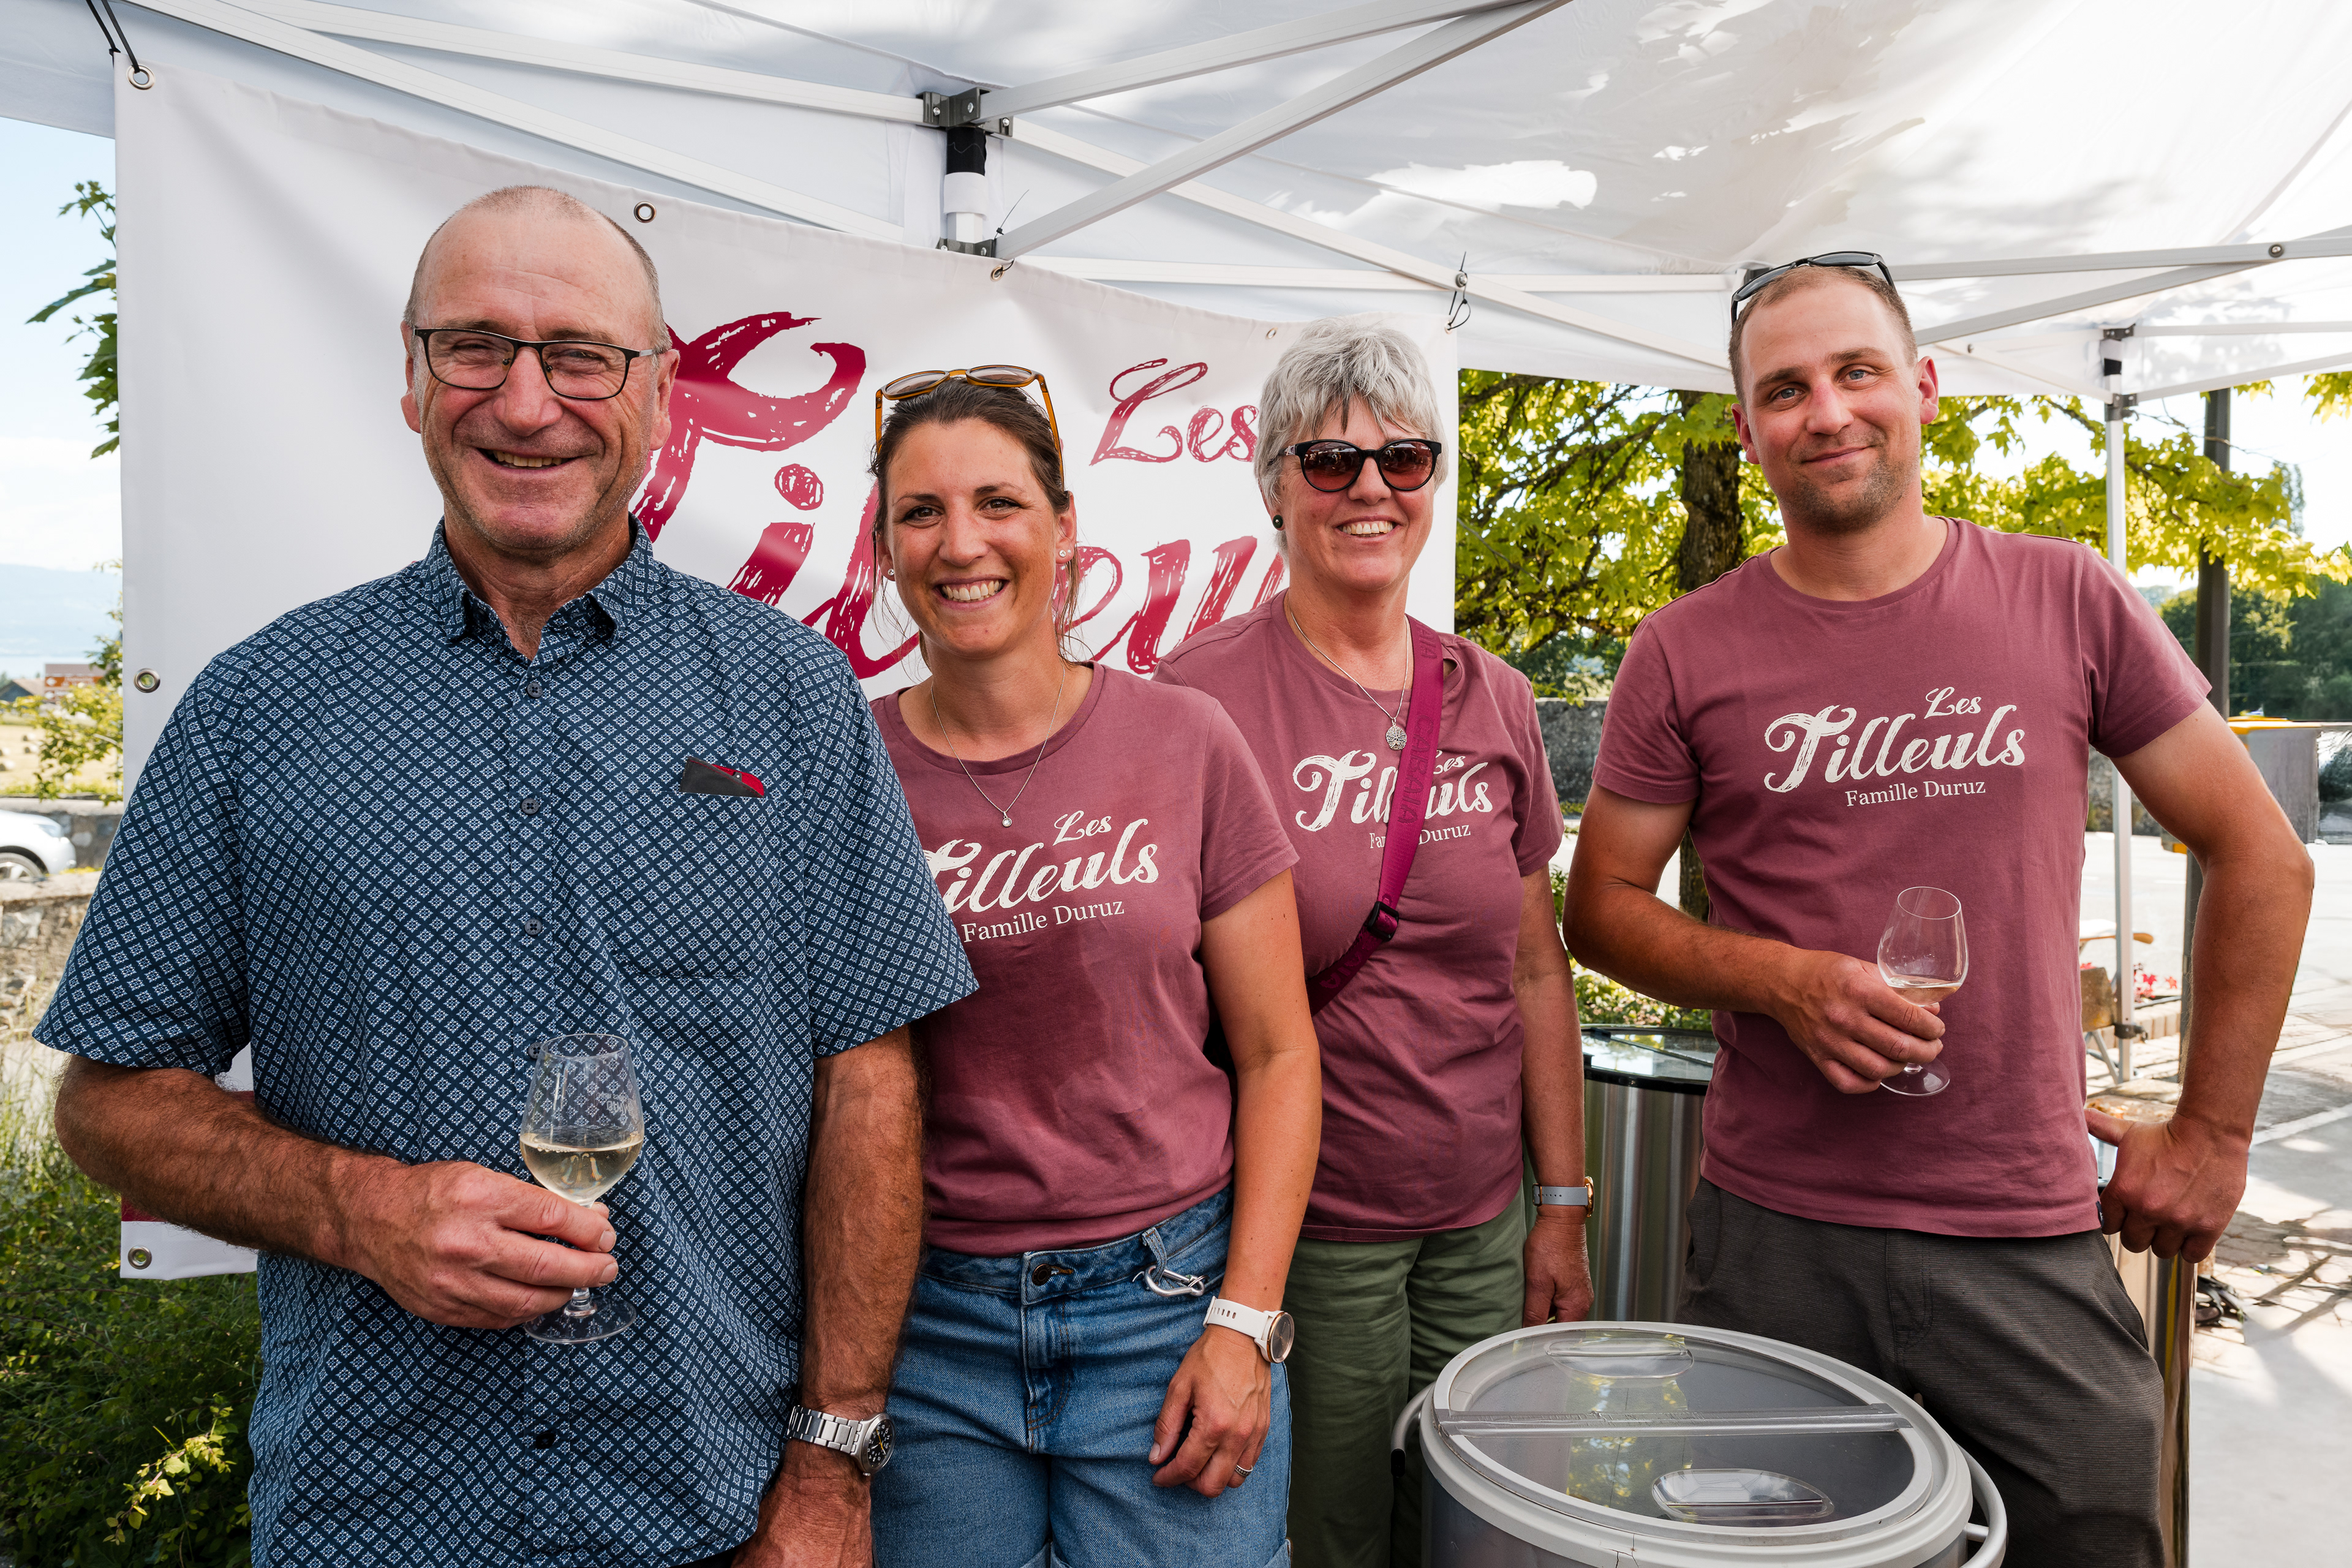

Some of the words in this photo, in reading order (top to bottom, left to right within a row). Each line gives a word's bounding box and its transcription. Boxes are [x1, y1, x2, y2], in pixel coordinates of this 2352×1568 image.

[1089, 358, 1259, 467] Les
[1924, 687, 1982, 719] Les
[1763, 704, 2026, 793] Tilleuls
[1397, 714, 1435, 826] CABAIA
[1845, 783, 1918, 807] Famille
[1923, 778, 1986, 798] Duruz
[1052, 810, 1112, 846] Les
[1418, 824, 1471, 845] Duruz
[961, 911, 1048, 943] Famille
[1053, 900, 1125, 925] Duruz
